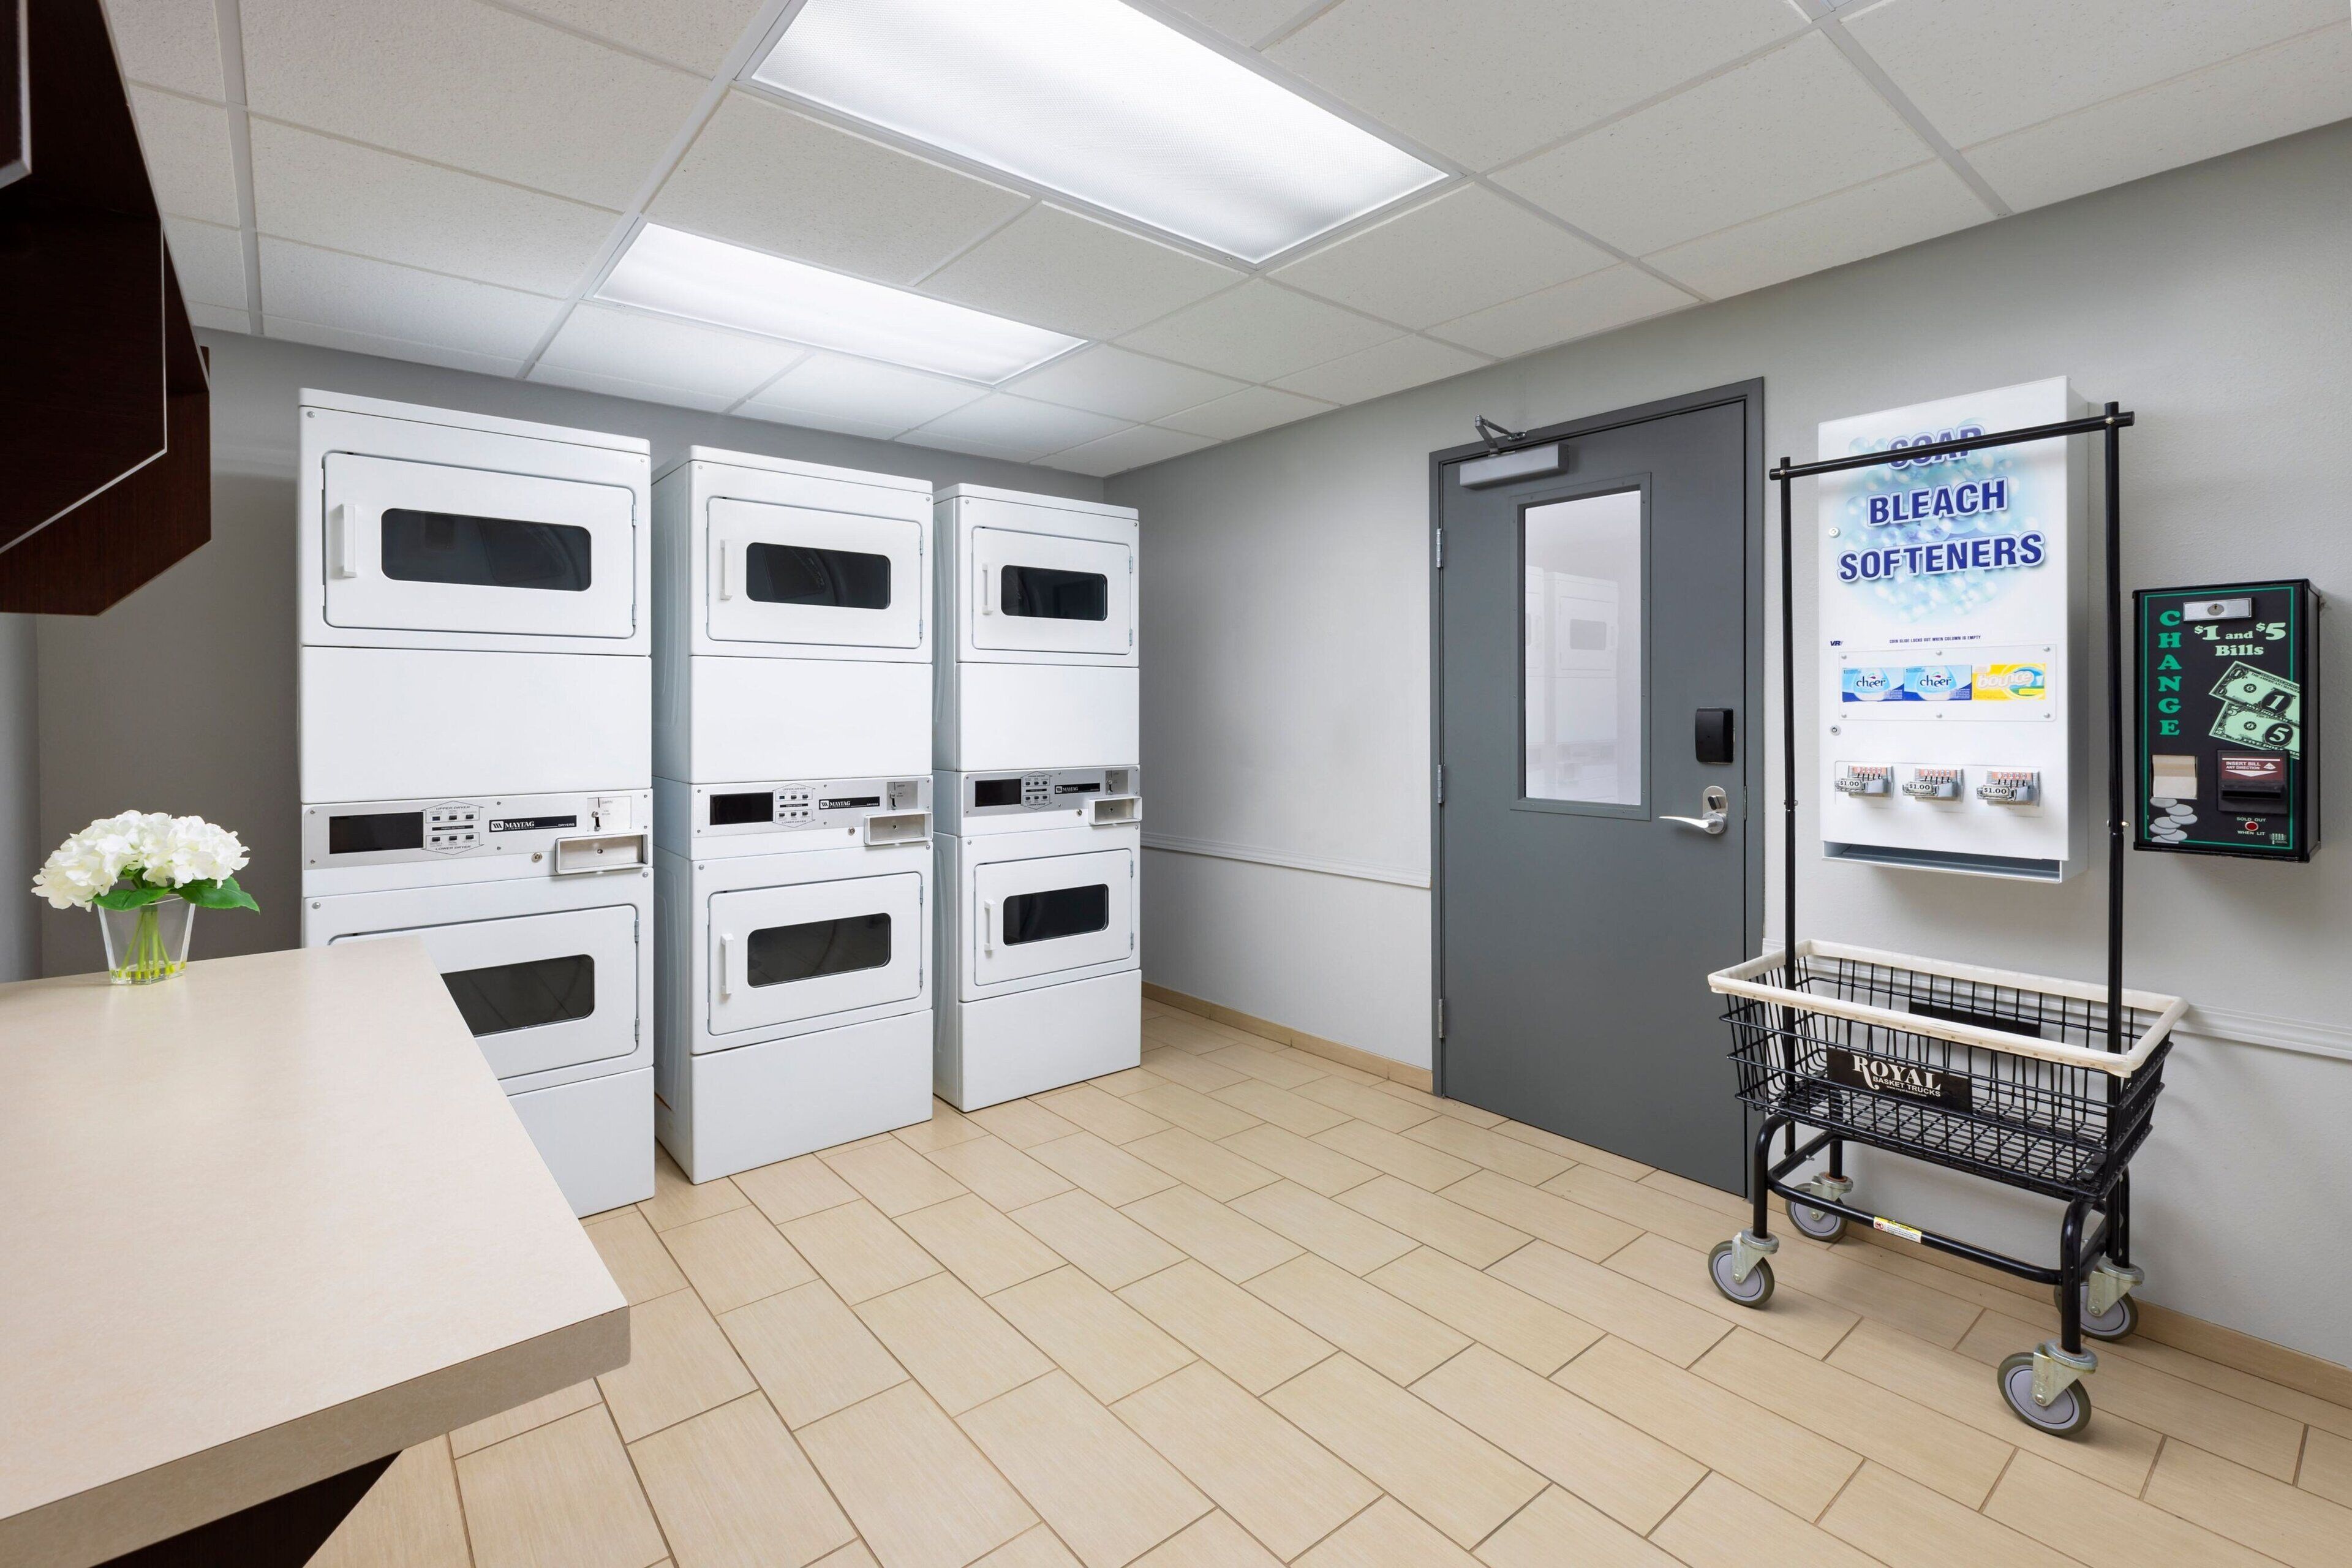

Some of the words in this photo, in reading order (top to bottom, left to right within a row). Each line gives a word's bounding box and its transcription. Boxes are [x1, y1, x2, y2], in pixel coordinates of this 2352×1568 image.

[1869, 480, 2005, 525] BLEACH
[1839, 533, 2043, 581] SOFTENERS
[2194, 625, 2221, 641] $1
[2225, 631, 2253, 639] and
[2255, 622, 2286, 641] $5
[2215, 644, 2264, 657] Bills
[1856, 676, 1886, 688] cheer
[1920, 675, 1952, 687] cheer
[1977, 671, 2034, 689] bounce
[2157, 610, 2182, 736] CHANGE
[2266, 695, 2285, 710] 1
[2269, 726, 2290, 742] 5
[1852, 1054, 1942, 1090] ROYAL
[1872, 1076, 1905, 1088] BASKET
[1907, 1084, 1941, 1097] TRUCKS
